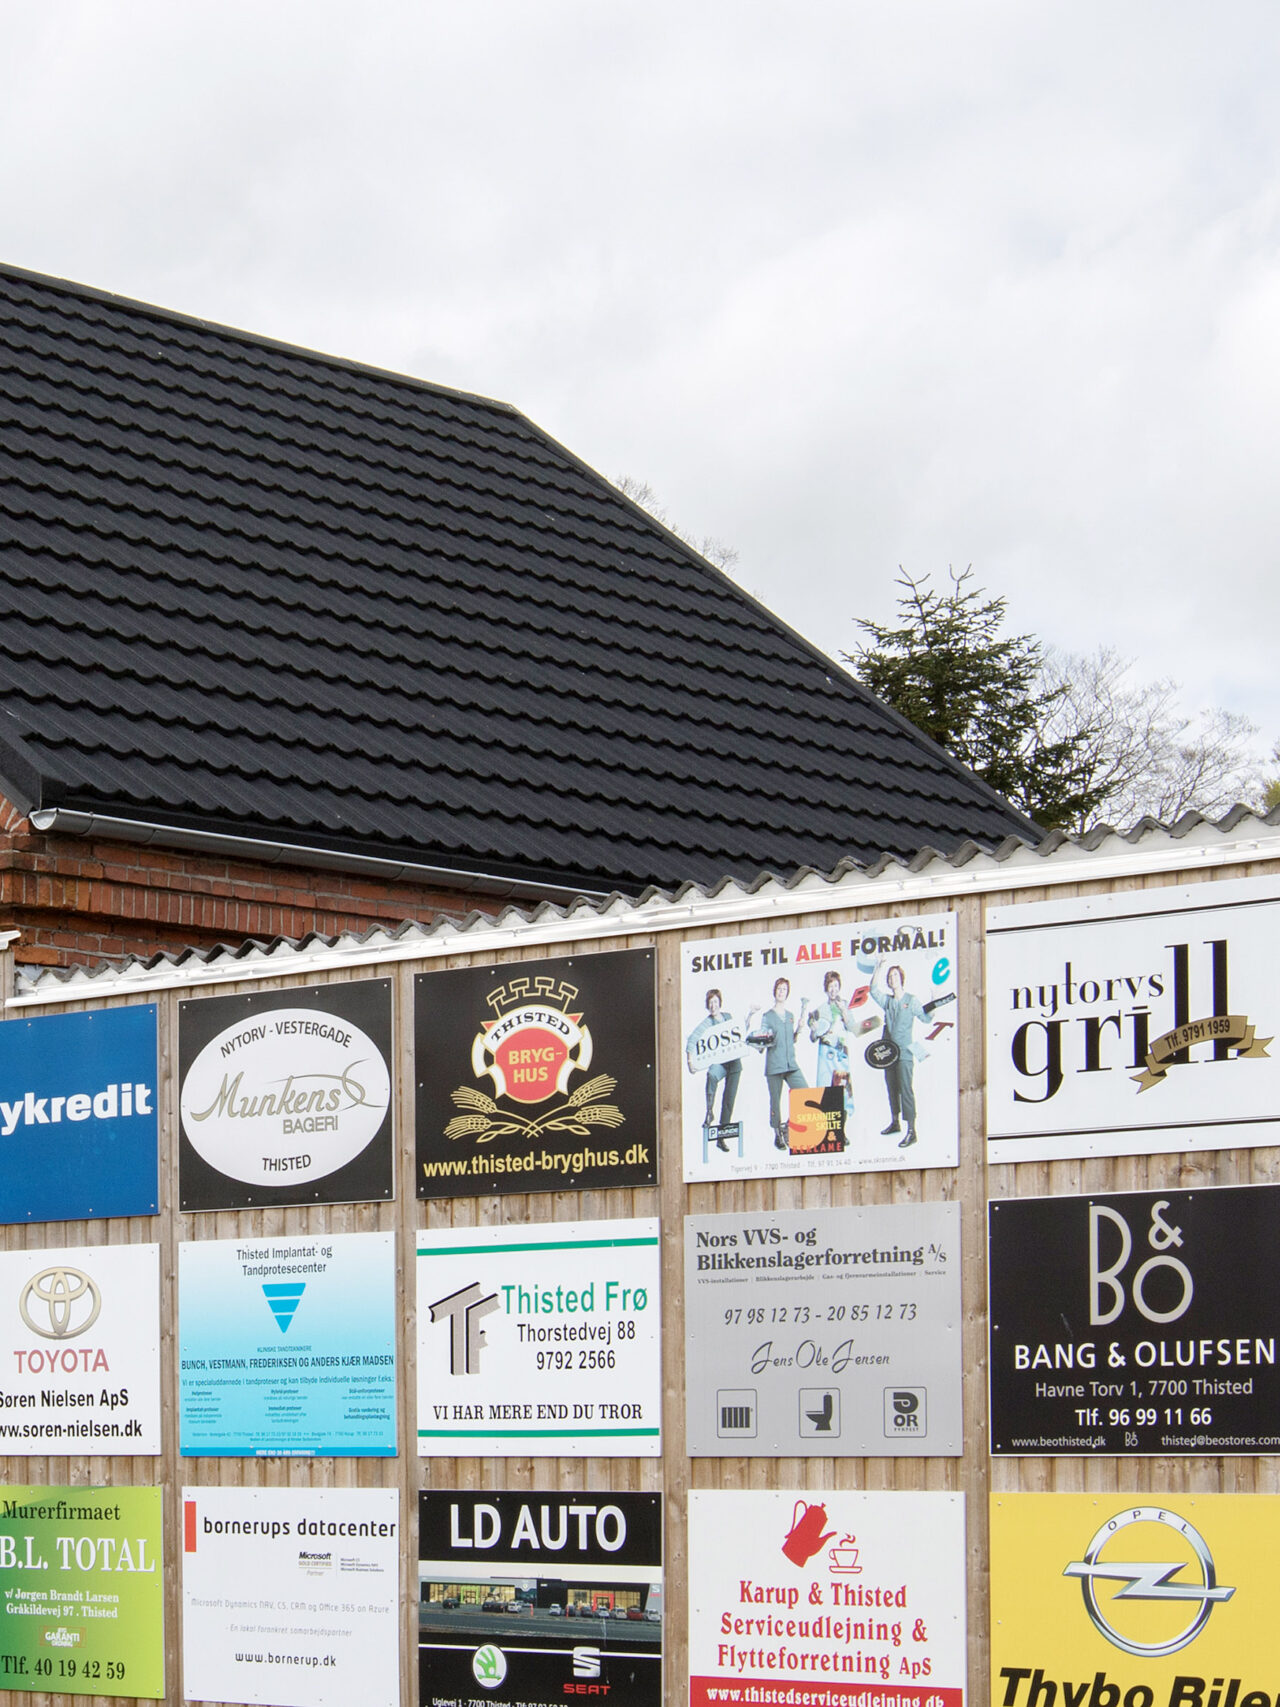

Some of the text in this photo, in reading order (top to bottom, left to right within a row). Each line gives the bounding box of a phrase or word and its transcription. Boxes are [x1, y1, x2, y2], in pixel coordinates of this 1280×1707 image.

[691, 927, 944, 973] SKILTE TIL ALLE FORMÅL!
[1010, 962, 1165, 1017] nytorvs
[491, 1012, 571, 1042] THISTED
[1011, 939, 1237, 1103] grill
[1164, 1019, 1230, 1050] Tlf. 9791 1959
[221, 1021, 352, 1058] NYTORV VESTERGADE
[696, 1026, 742, 1056] BOSS
[508, 1047, 563, 1065] BRYG-
[513, 1067, 548, 1083] HUS
[190, 1070, 369, 1122] Munkens
[283, 1115, 339, 1135] BAGERI
[262, 1154, 311, 1171] THISTED
[424, 1144, 649, 1177] www.thisted-bryghus.dk
[696, 1228, 816, 1248] Nors VVS- og
[236, 1246, 333, 1261] Thisted Implantat- og
[697, 1243, 947, 1271] Blikkenslagerforretning A/S
[242, 1262, 326, 1277] Tandprotesecenter
[501, 1281, 648, 1314] Thisted Frø
[517, 1321, 635, 1345] Thorstedvej 88
[14, 1348, 110, 1374] TOYOTA
[536, 1350, 616, 1370] 9792 2566
[751, 1339, 890, 1374] Jens Ole Jensen
[1014, 1338, 1275, 1370] BANG & OLUFSEN
[41, 1390, 95, 1407] Nielsen
[100, 1389, 129, 1410] ApS
[1036, 1378, 1253, 1398] Havne Torv 1, 7700 Thisted
[1012, 1435, 1280, 1448] www.beothisted.dk thisted@beostores.com
[2, 1501, 121, 1521] Murerfirmaet
[1107, 1509, 1189, 1534] OPEL
[204, 1517, 396, 1539] bornerups datacenter
[450, 1503, 627, 1552] LD AUTO
[56, 1538, 155, 1572] TOTAL
[740, 1580, 906, 1610] Karup & Thisted
[721, 1612, 928, 1647] Serviceudlejning &
[235, 1653, 336, 1668] www.bornerup.dk
[718, 1643, 931, 1680] Flytteforretning ApS
[563, 1683, 610, 1695] SEAT
[999, 1667, 1154, 1707] Thybo
